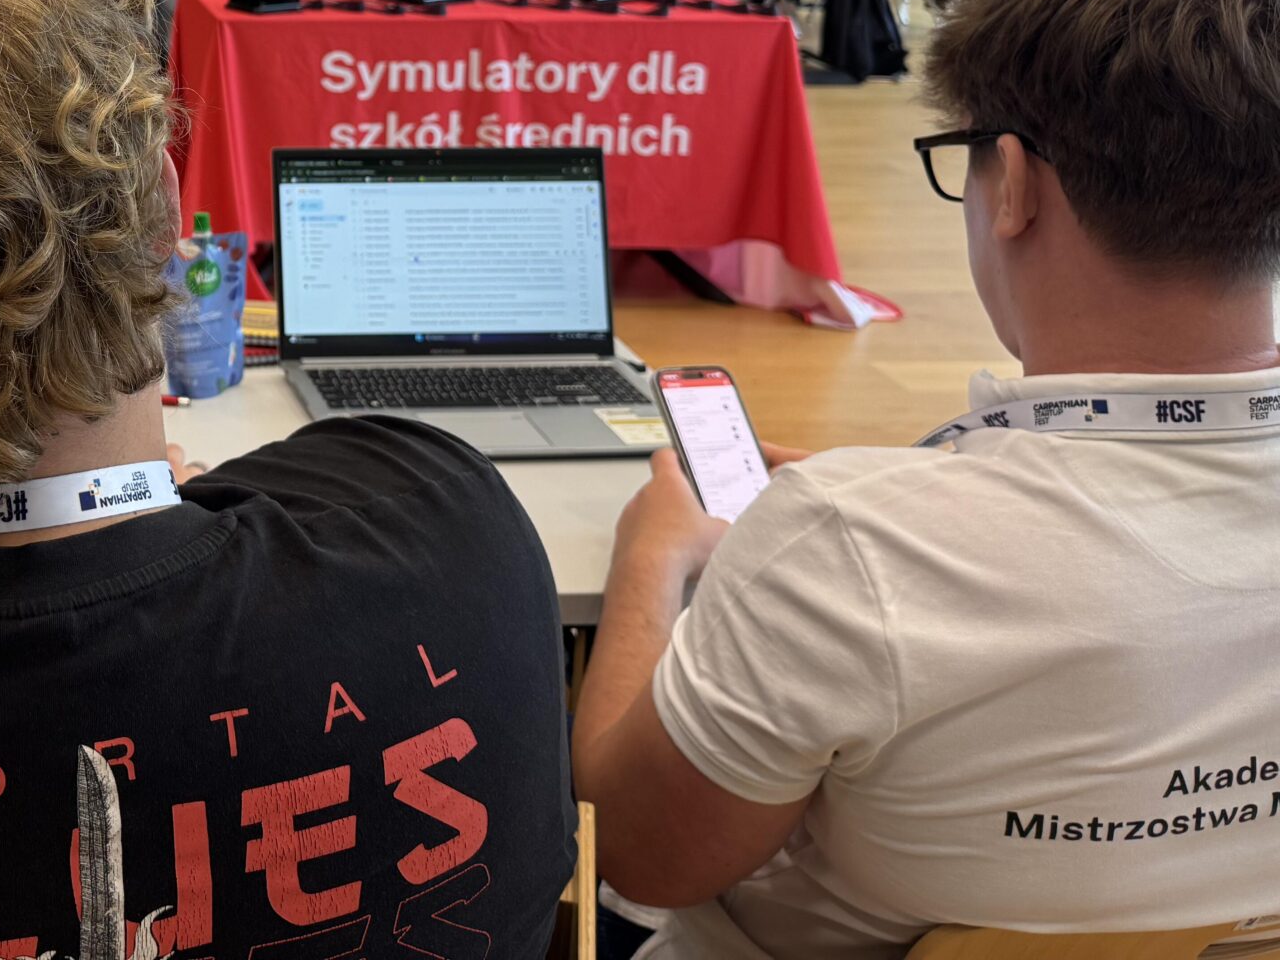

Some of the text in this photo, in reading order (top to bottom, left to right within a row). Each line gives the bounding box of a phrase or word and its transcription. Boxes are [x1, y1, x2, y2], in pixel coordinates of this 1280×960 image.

[321, 49, 708, 101] Symulatory dla
[330, 110, 690, 156] szkół średnich
[1033, 399, 1088, 411] CARPATHIAN
[1156, 399, 1206, 424] #CSF
[1034, 408, 1063, 419] STARTUP
[1034, 417, 1049, 426] FEST
[1250, 412, 1269, 421] FEST
[131, 470, 146, 481] FEST
[121, 480, 149, 493] STARTUP
[100, 489, 152, 508] CARPATHIAN
[1162, 756, 1280, 798] Akade
[1004, 802, 1259, 842] Mistrzostwa
